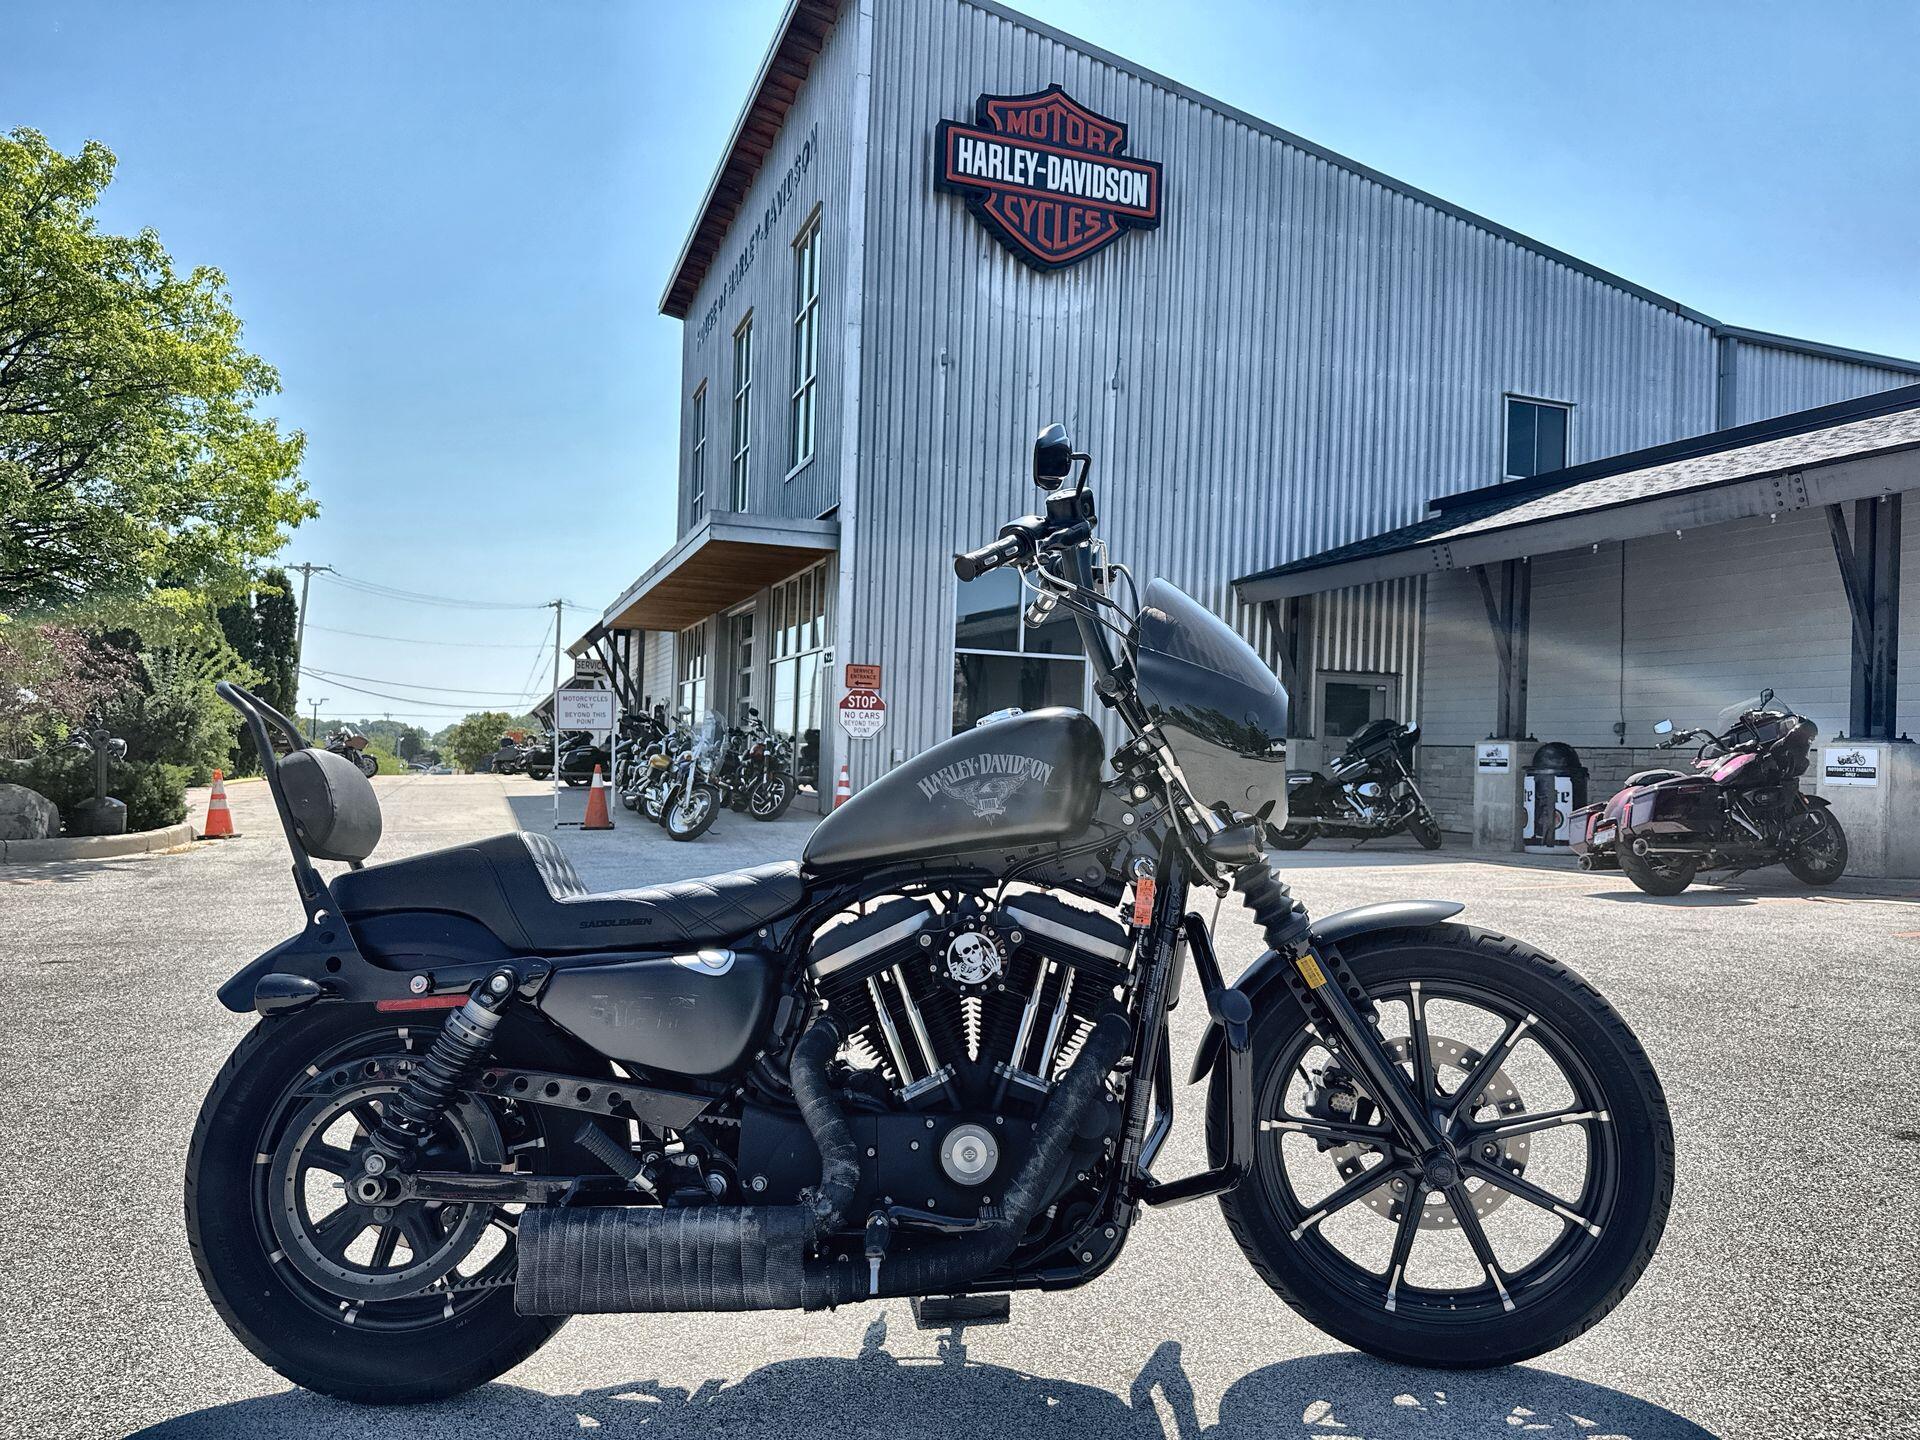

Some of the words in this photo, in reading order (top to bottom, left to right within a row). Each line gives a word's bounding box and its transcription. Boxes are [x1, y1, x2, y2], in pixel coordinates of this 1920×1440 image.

[1006, 103, 1106, 152] MOTOR
[957, 137, 1148, 208] HARLEY-DAVIDSON
[1003, 196, 1102, 250] CYCLES
[848, 695, 877, 708] STOP
[859, 711, 880, 719] CARS
[579, 917, 653, 929] SADDLEMEN
